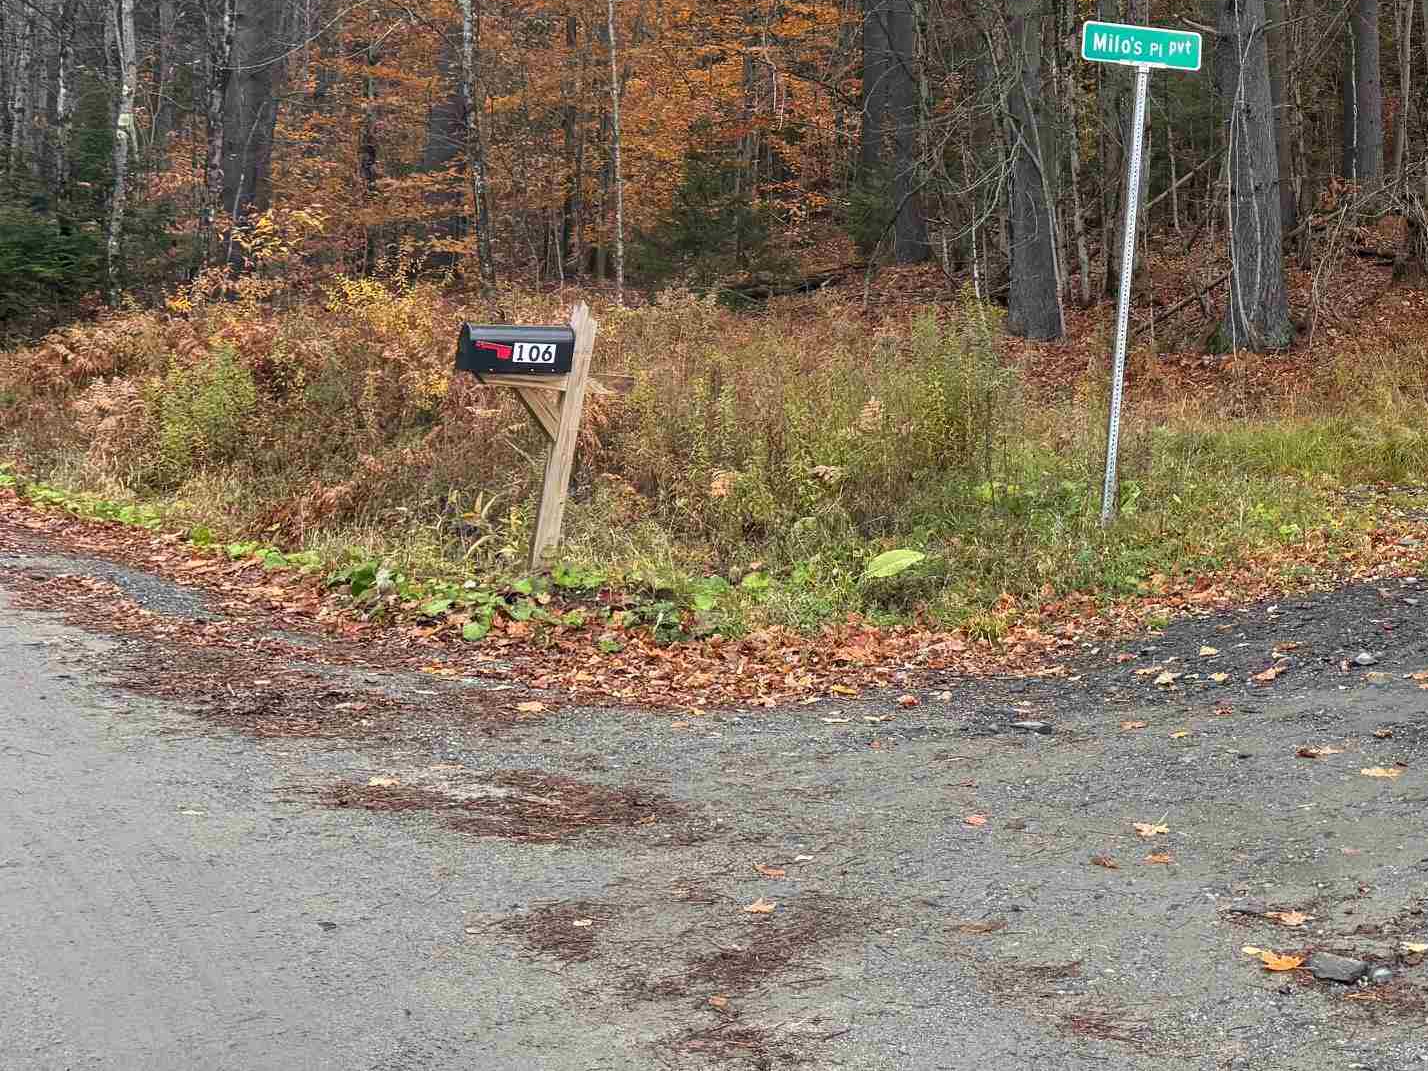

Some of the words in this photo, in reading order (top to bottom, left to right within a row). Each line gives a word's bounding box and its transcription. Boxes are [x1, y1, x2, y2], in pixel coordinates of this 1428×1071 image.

[1093, 33, 1143, 55] Milo's
[1169, 41, 1192, 56] pvt
[517, 344, 553, 361] 106
